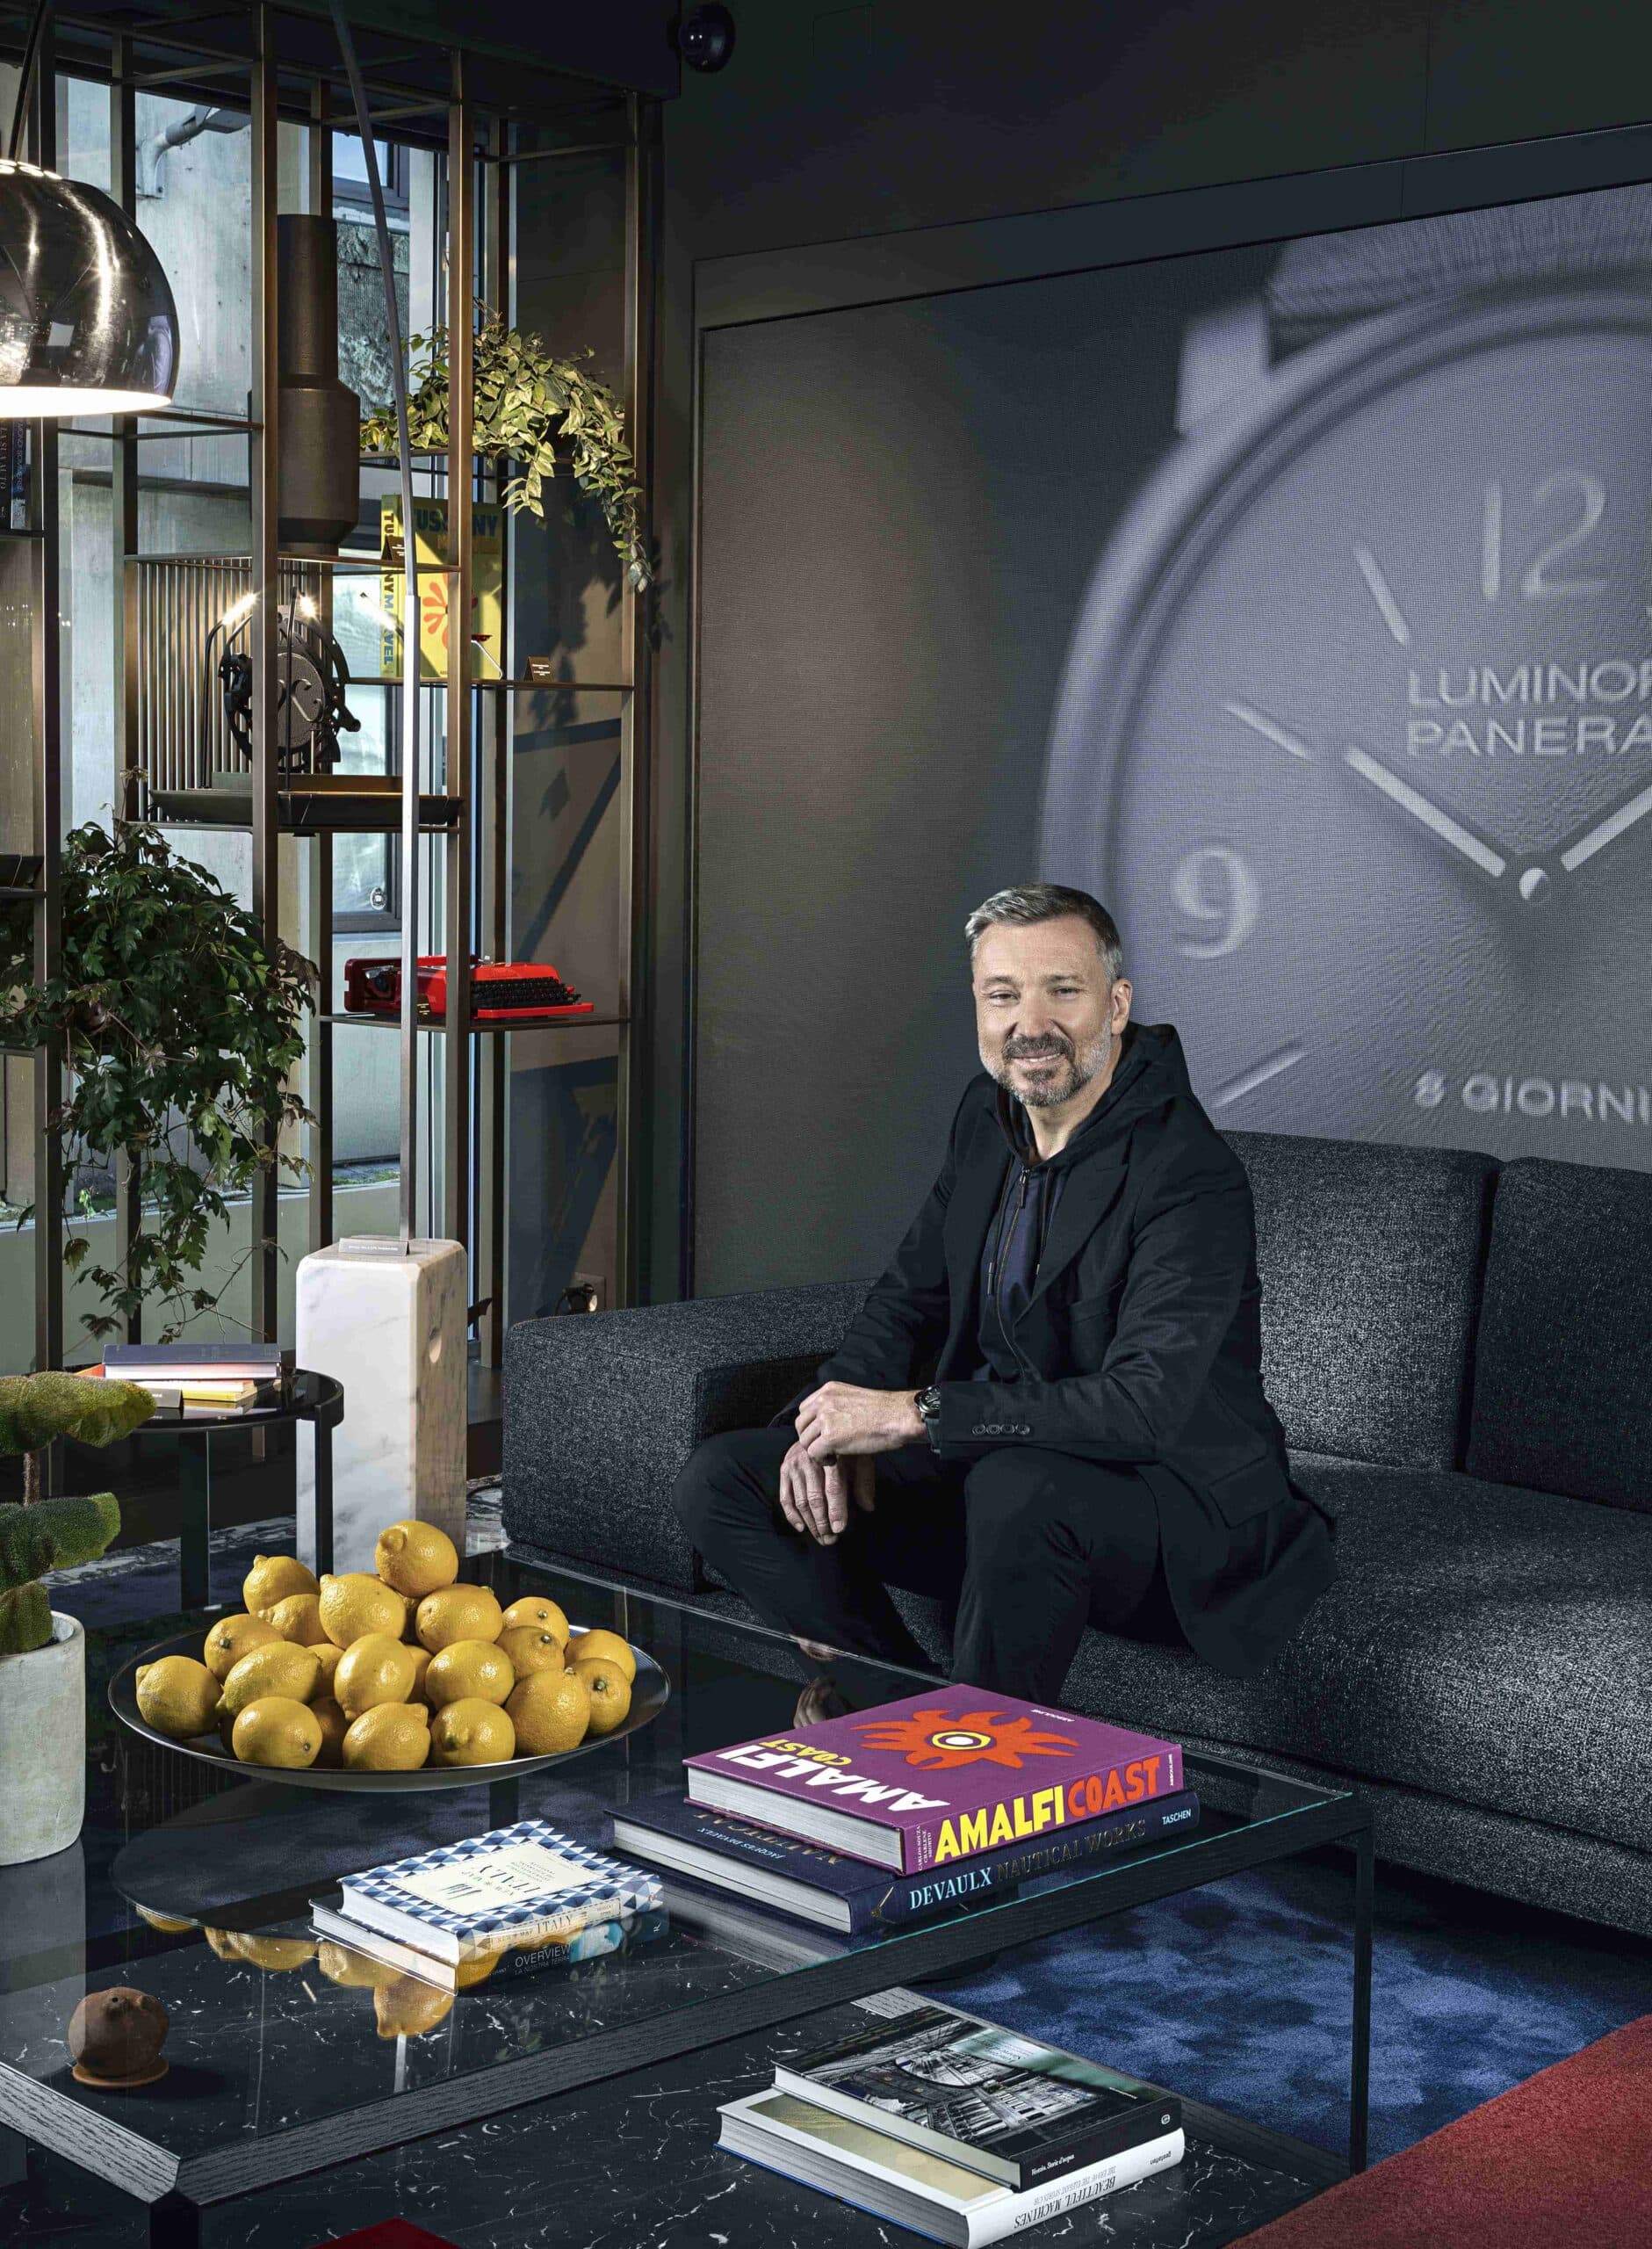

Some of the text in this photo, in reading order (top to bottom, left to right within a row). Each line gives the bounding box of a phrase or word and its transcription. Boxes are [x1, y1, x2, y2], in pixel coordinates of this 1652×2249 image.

[1482, 469, 1607, 601] 12
[1171, 846, 1257, 958] 9
[715, 1745, 950, 1811] AMALFI
[759, 1739, 853, 1767] COAST
[934, 1755, 1160, 1863] AMALFI COAST
[1161, 1809, 1192, 1826] TASCHEN
[697, 1827, 787, 1860] JACQUES DEVAULX
[909, 1819, 1146, 1911] DEVAULX NAUTICAL WORKS
[537, 1914, 574, 1934] ITALY
[515, 1943, 571, 1968] OVERVIEW
[1014, 2176, 1116, 2229] BEAUTIFUL MACHINES
